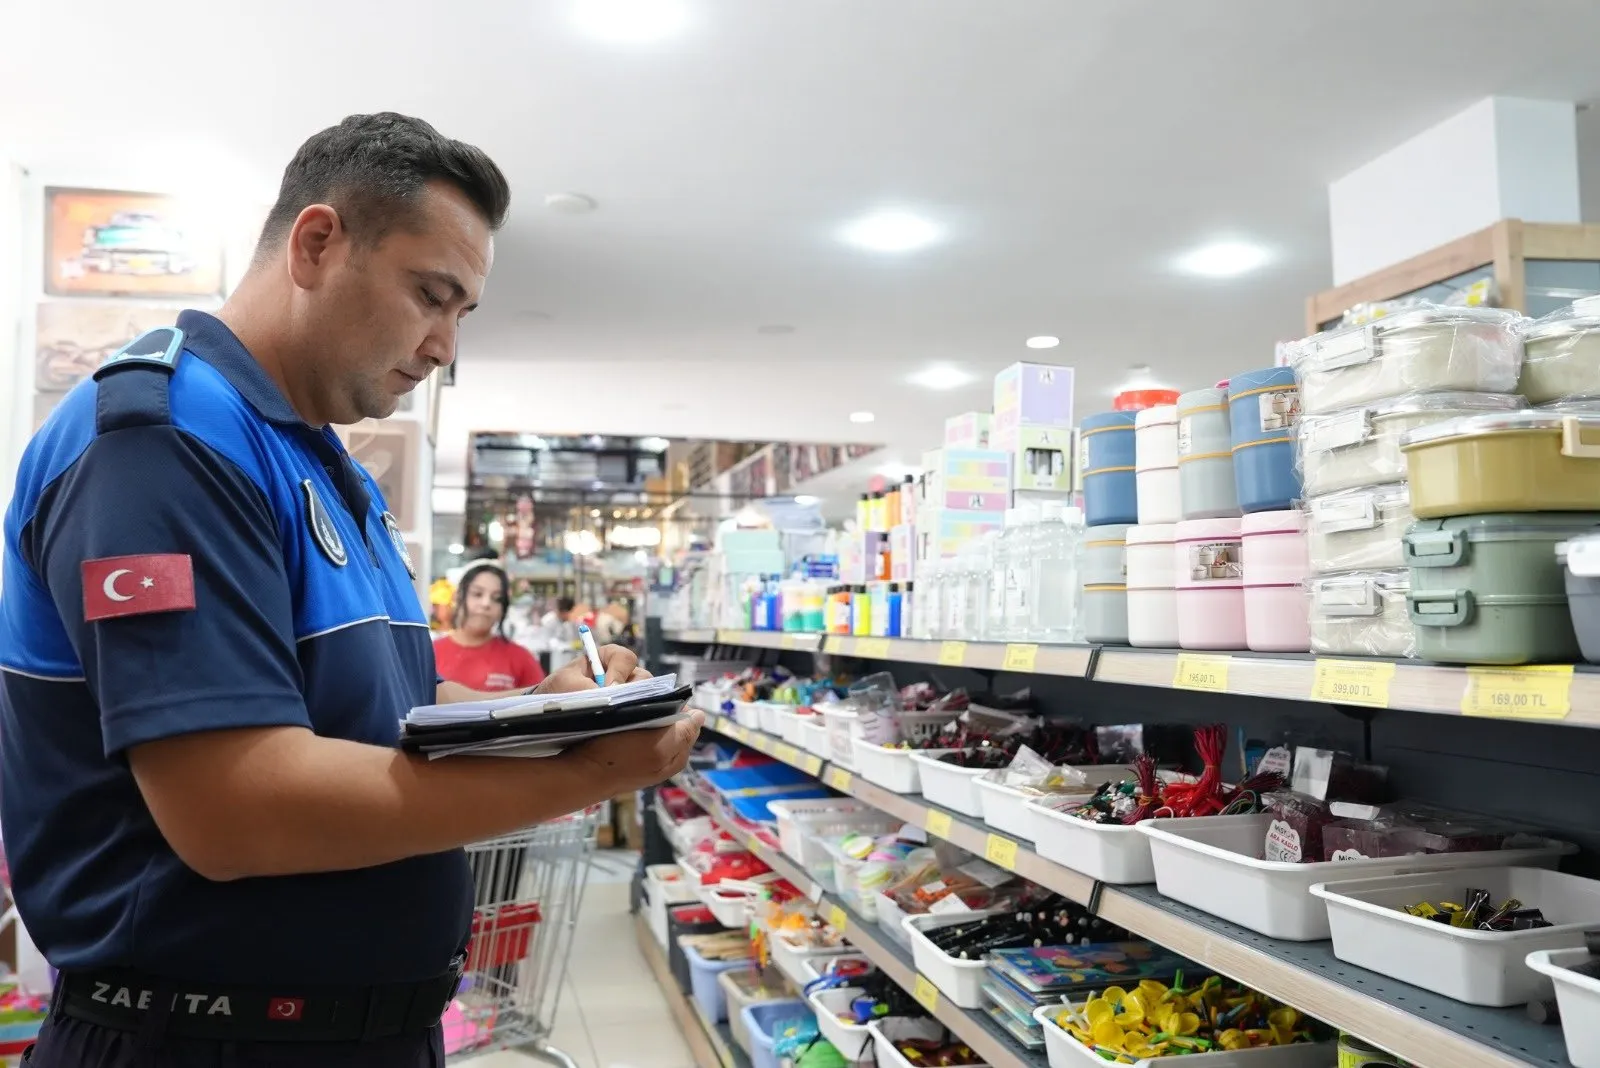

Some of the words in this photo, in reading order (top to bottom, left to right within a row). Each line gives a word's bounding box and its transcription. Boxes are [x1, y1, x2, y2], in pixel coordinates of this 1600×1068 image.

[1333, 683, 1360, 695] 399,00
[1361, 685, 1372, 696] TL
[1531, 694, 1547, 706] TL
